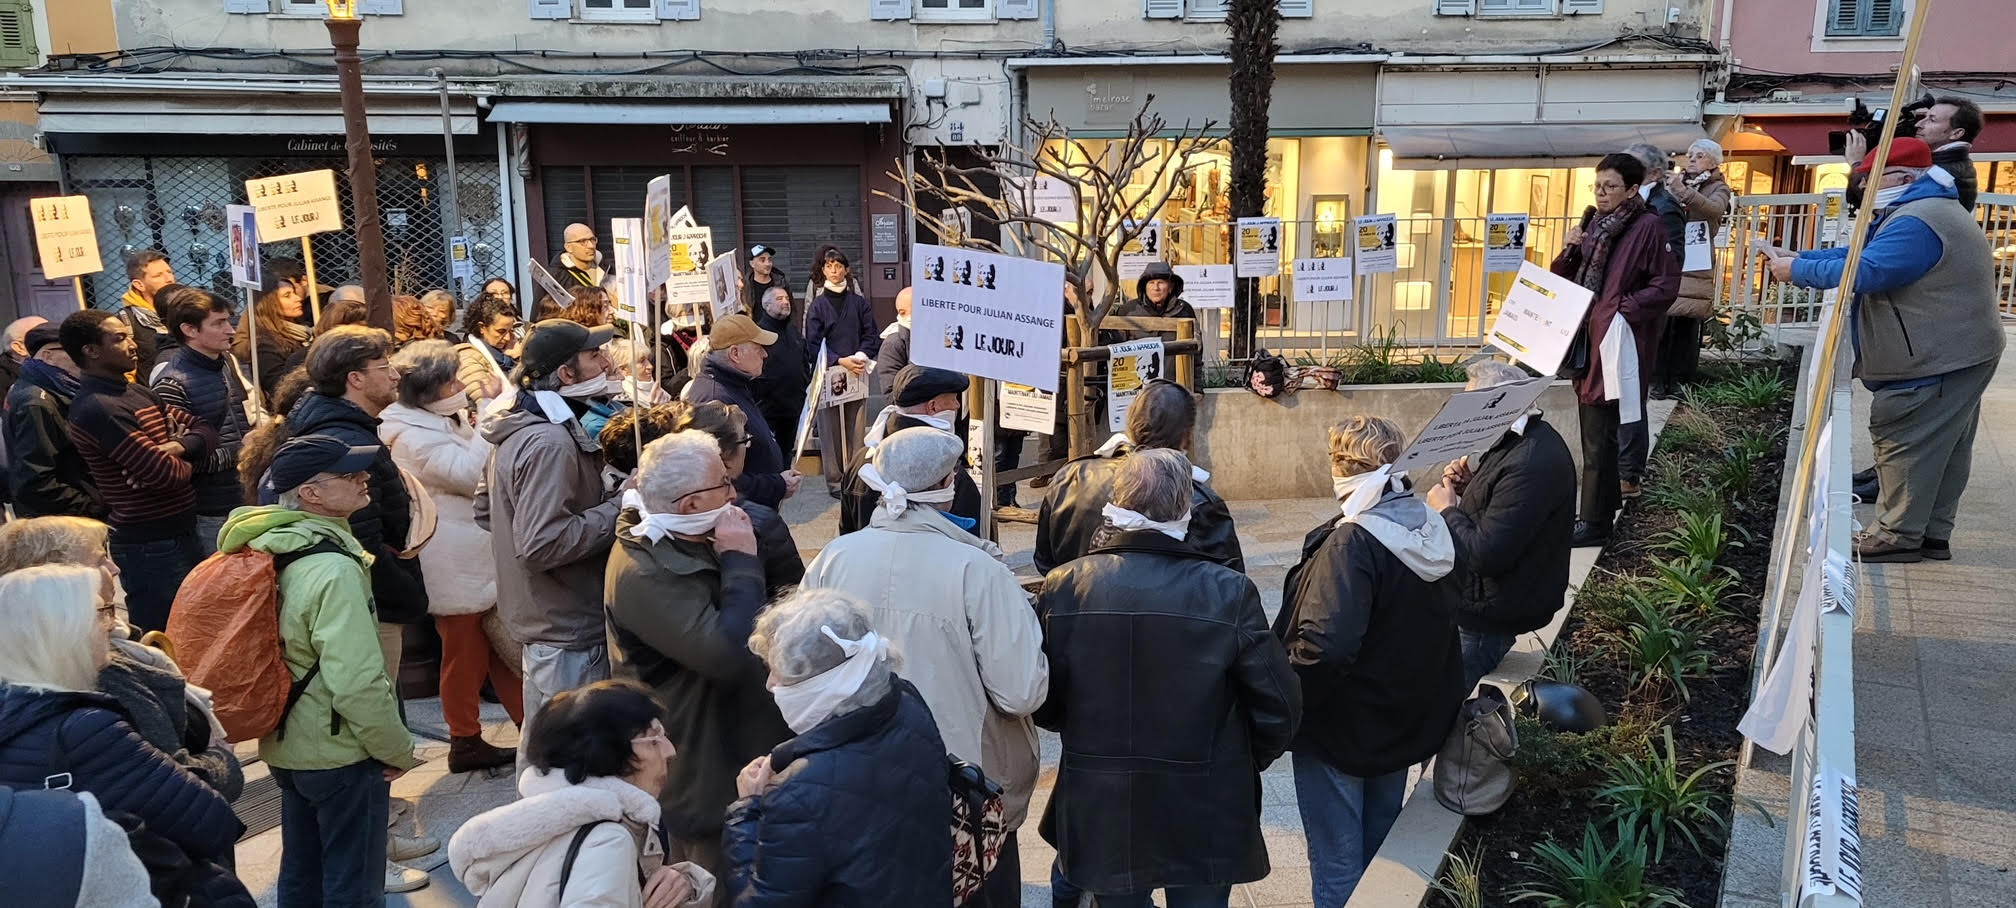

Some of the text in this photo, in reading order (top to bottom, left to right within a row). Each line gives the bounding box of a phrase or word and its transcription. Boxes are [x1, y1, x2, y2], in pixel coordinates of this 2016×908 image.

[288, 139, 328, 151] Cabinet
[330, 141, 340, 150] de
[921, 298, 1055, 329] LIBERTE POUR JULIAN ASSANGE
[975, 333, 1024, 358] LE JOUR J
[1113, 357, 1125, 367] 20
